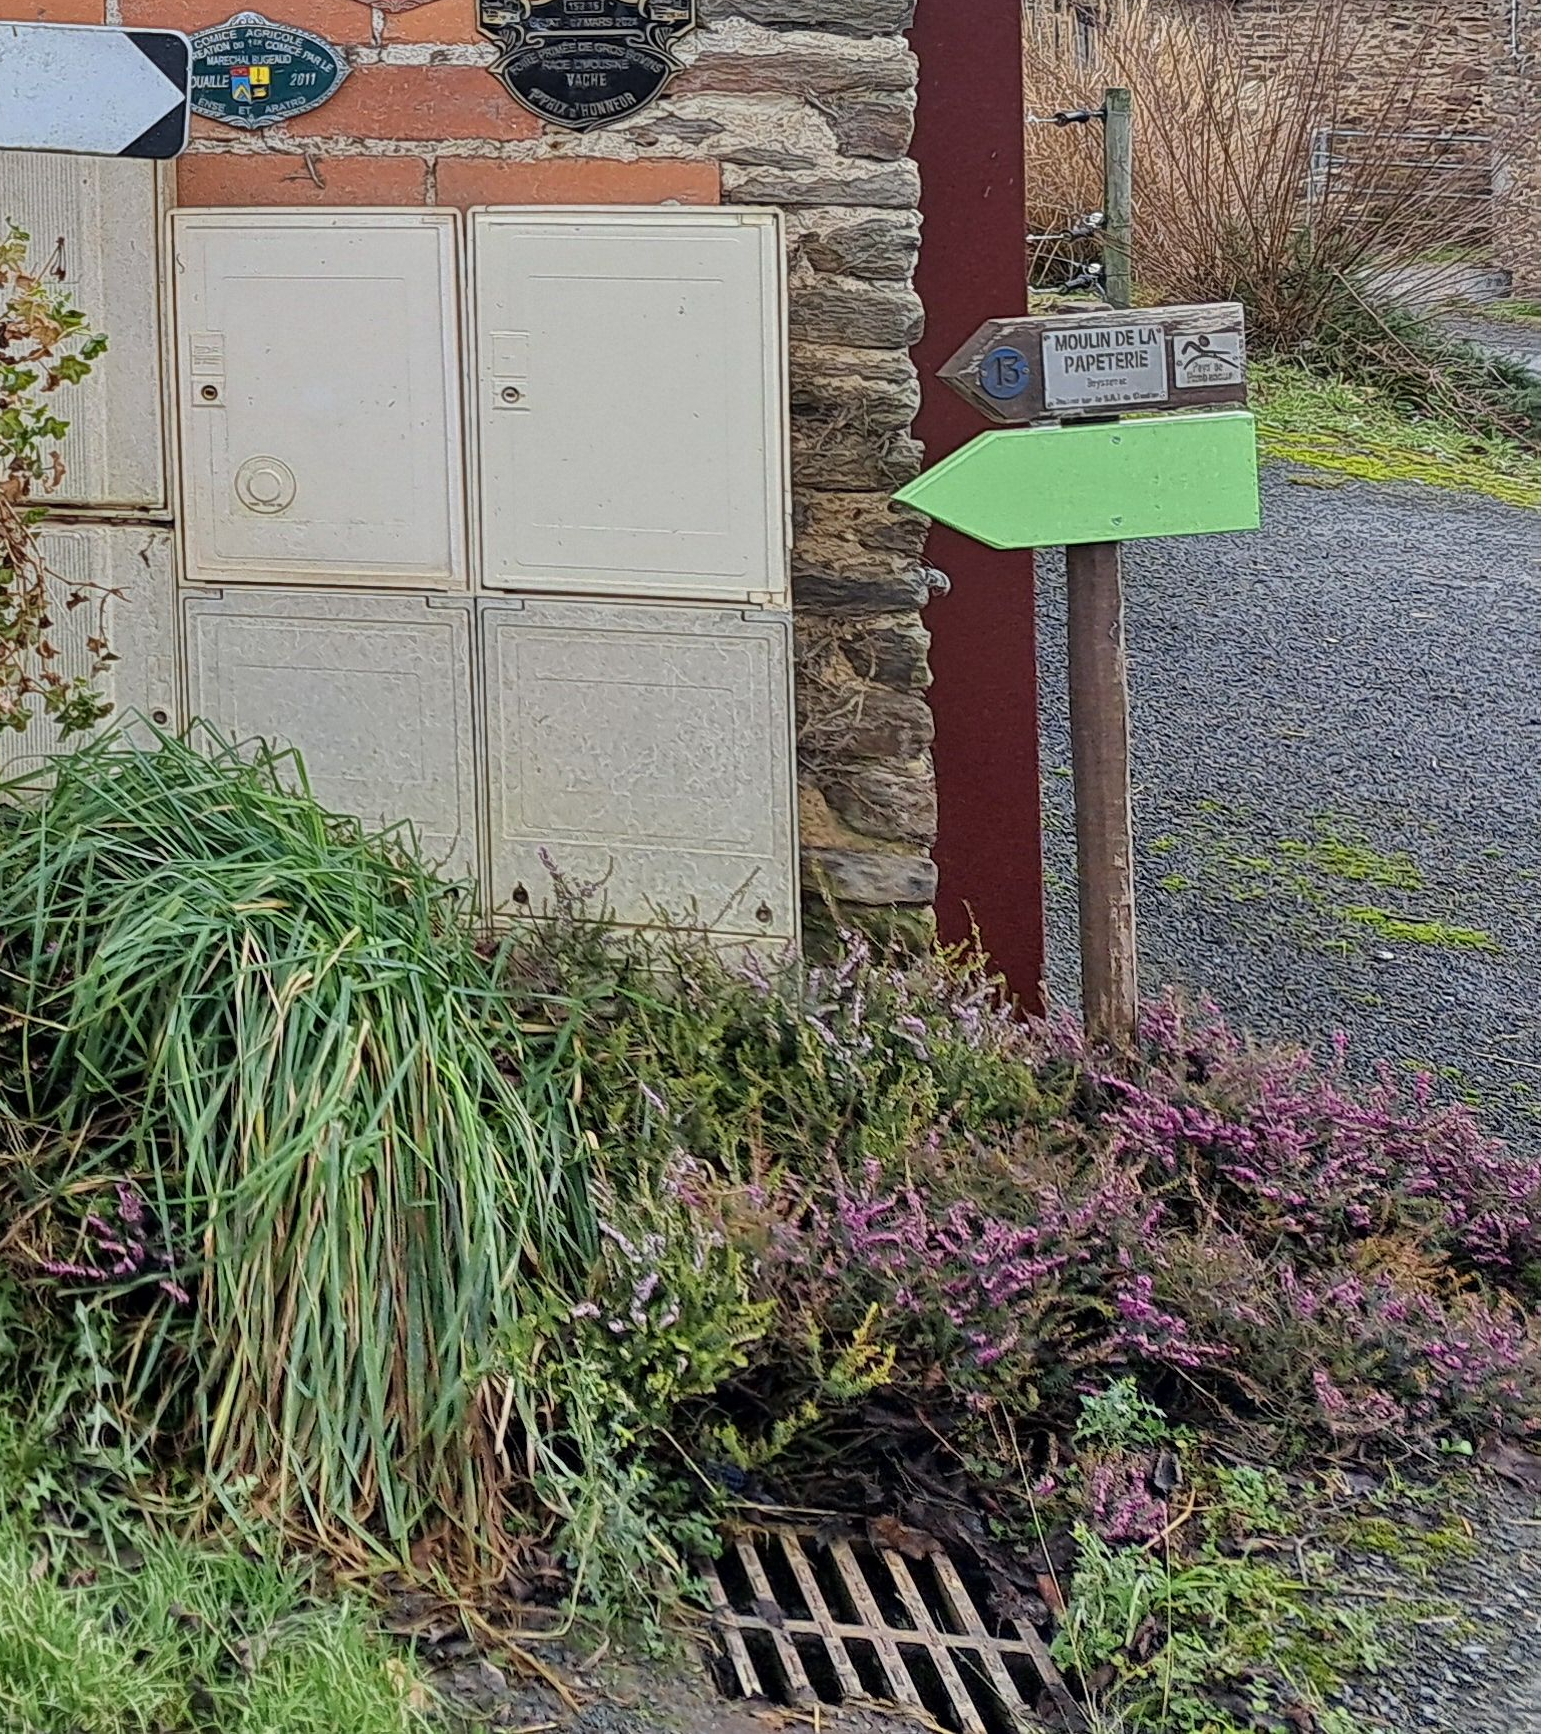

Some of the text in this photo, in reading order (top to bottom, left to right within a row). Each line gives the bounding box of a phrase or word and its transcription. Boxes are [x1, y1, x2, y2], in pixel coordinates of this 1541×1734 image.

[584, 18, 613, 27] MARS
[194, 29, 304, 49] COMICE AGRICOLE
[207, 55, 291, 65] MARECHAL BUGEAUD
[265, 41, 334, 73] COMICE PAR LE
[290, 72, 316, 86] 2011
[567, 73, 608, 86] VACHE
[197, 96, 306, 115] ENSE ET ARATRO
[1055, 328, 1158, 351] MOULIN DE LA
[1064, 350, 1149, 373] PAPETERIE
